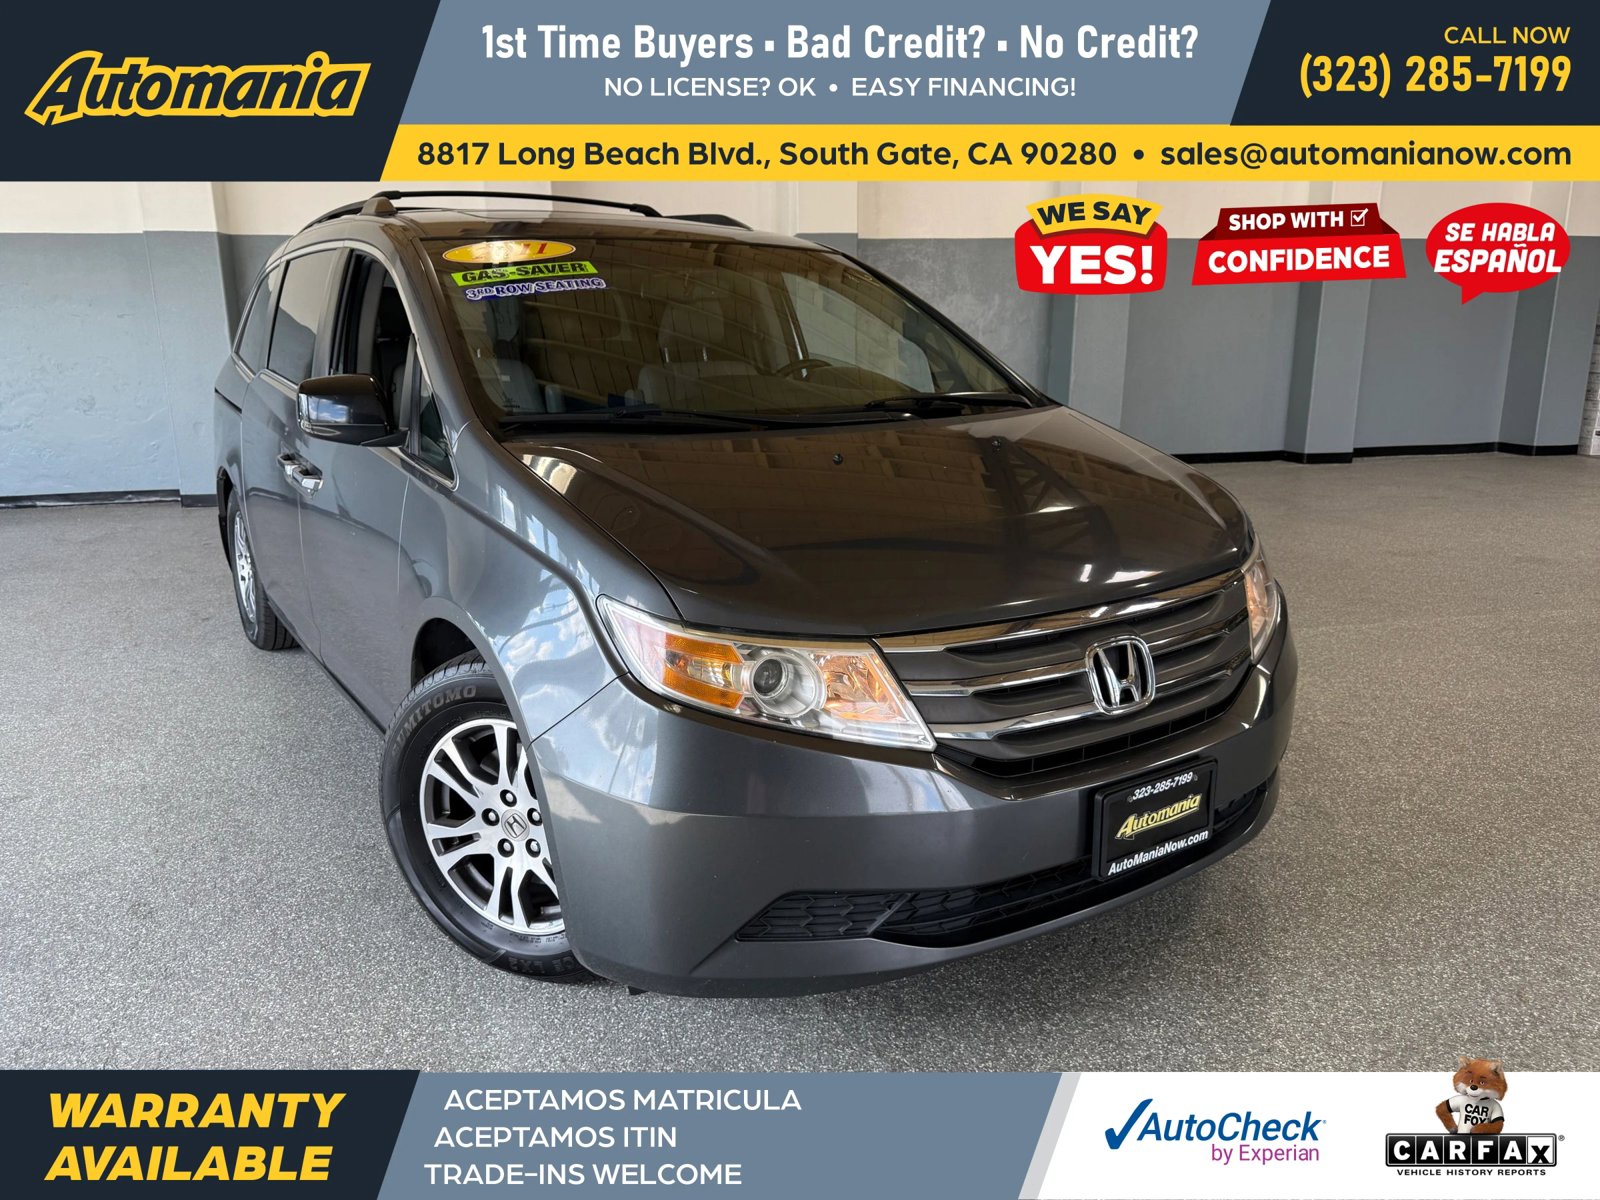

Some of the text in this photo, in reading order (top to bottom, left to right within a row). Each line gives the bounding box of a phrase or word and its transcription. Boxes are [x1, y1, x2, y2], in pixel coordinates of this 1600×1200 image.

[461, 262, 587, 283] GAS-SAVER
[495, 283, 531, 297] ROW
[534, 278, 605, 293] SEATING
[1132, 772, 1193, 800] 323-285-7199
[1115, 793, 1202, 840] Automania
[1108, 830, 1208, 876] AutoManiaNow.com
